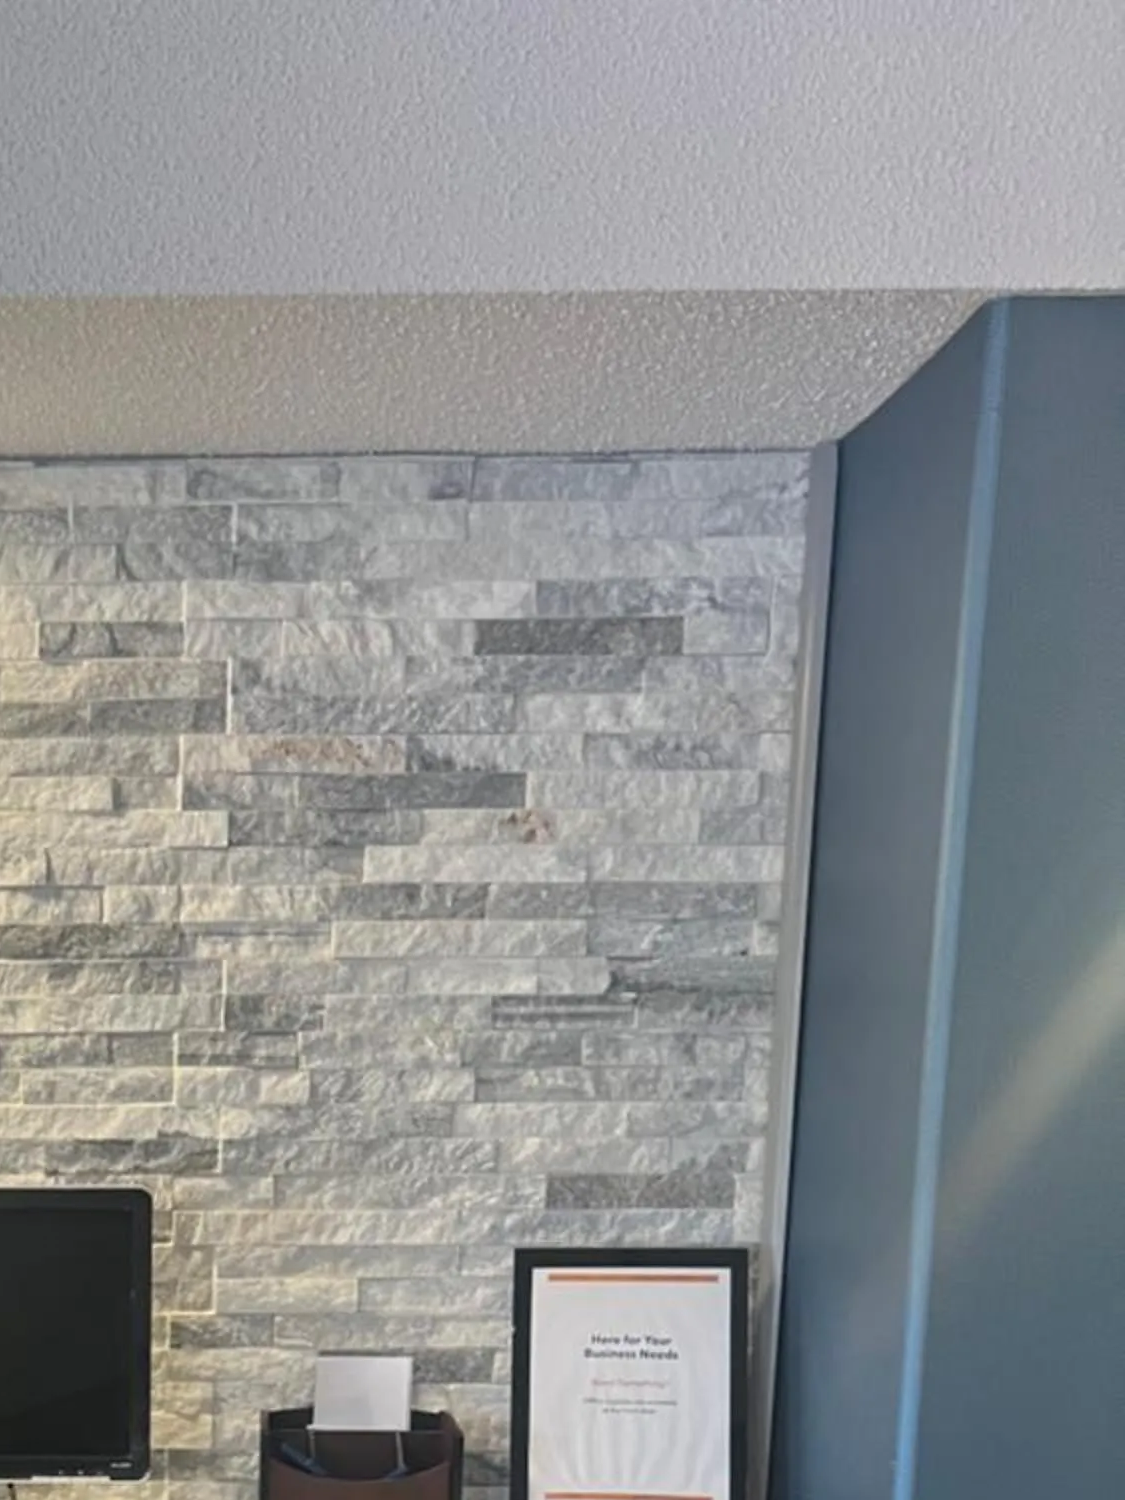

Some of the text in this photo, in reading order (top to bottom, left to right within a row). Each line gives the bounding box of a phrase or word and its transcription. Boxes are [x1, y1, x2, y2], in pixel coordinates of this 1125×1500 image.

[590, 1333, 673, 1346] Here for Your
[584, 1347, 679, 1360] Business Needs
